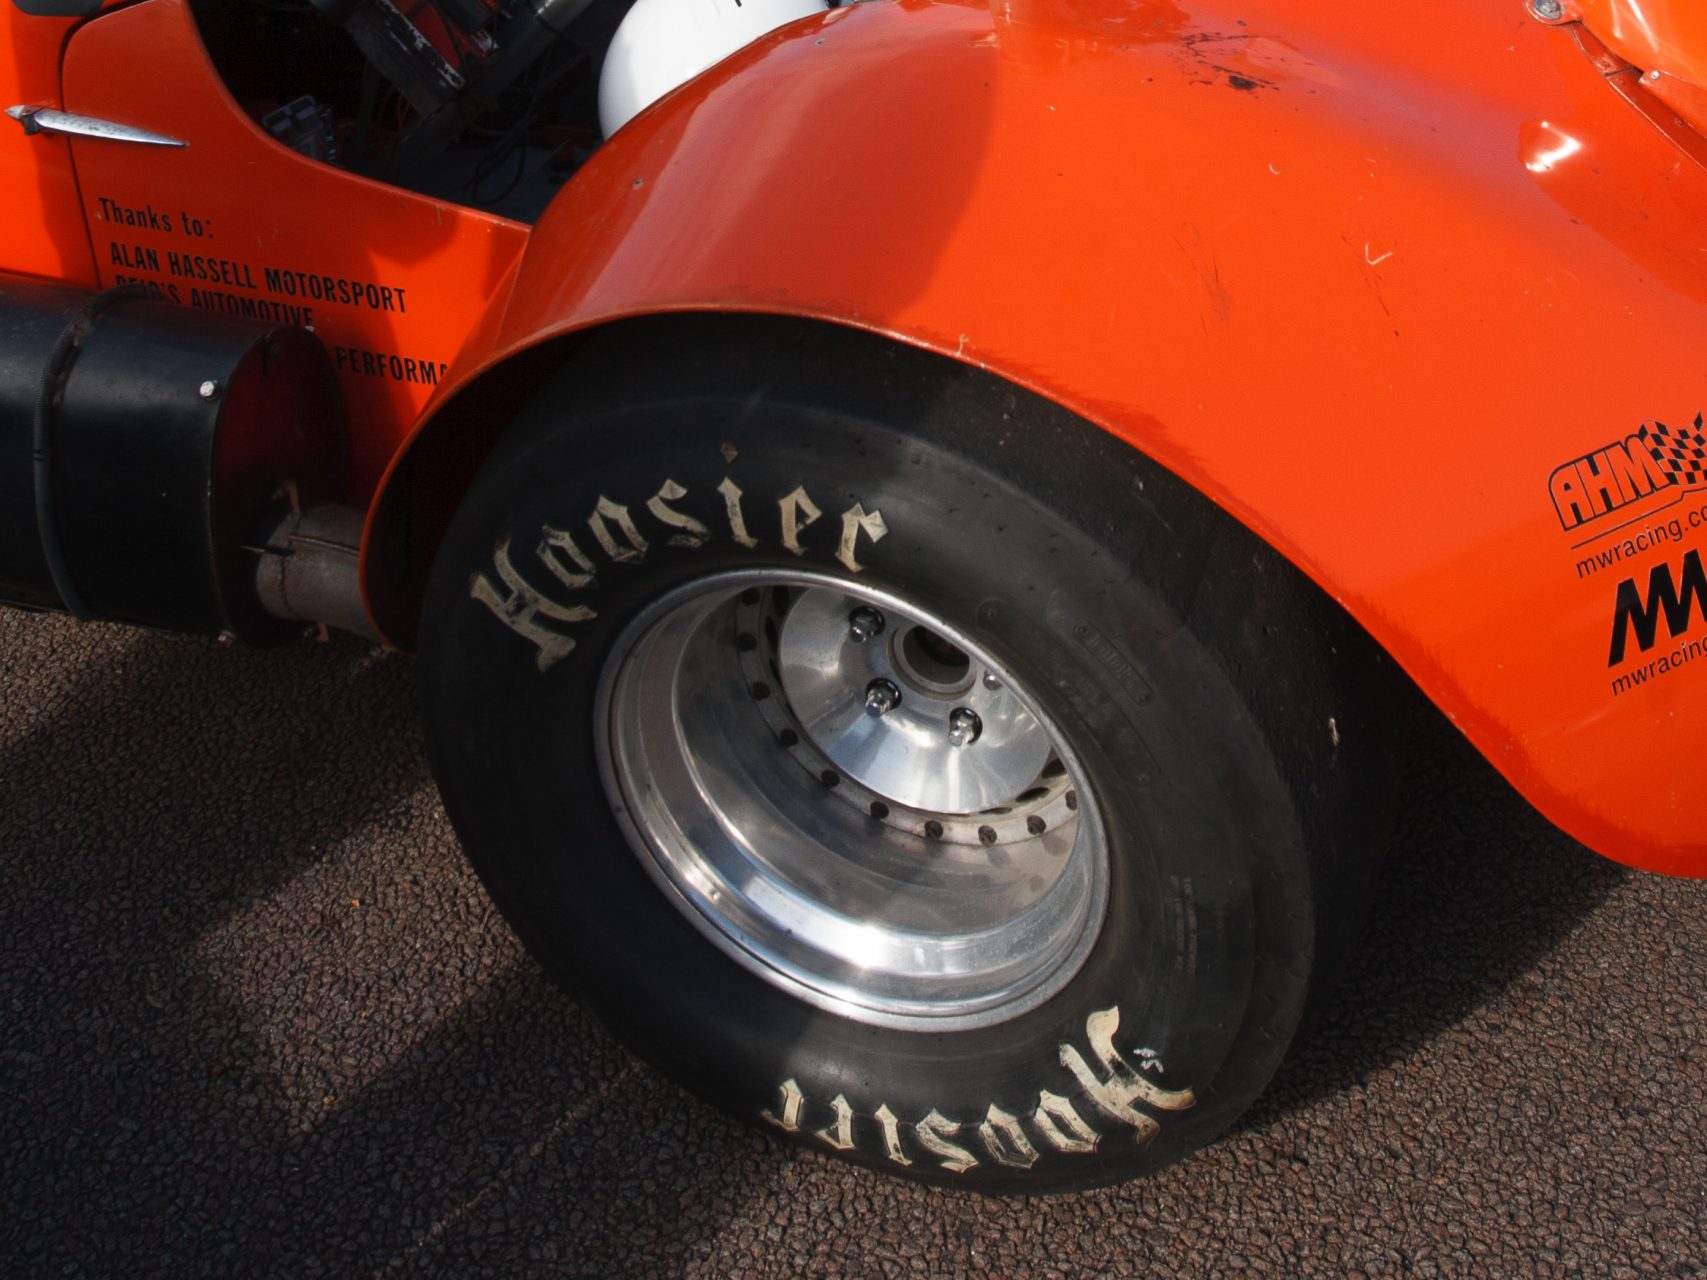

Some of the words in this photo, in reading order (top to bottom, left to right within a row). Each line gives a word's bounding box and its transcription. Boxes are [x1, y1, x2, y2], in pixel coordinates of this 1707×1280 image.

[98, 197, 172, 232] Thanks
[181, 211, 215, 239] to:
[110, 241, 160, 273] ALAN
[167, 251, 258, 290] HASSELL
[263, 266, 406, 313] MOTORSPORT
[1551, 436, 1671, 529] AHM
[470, 441, 889, 672] Hoosier
